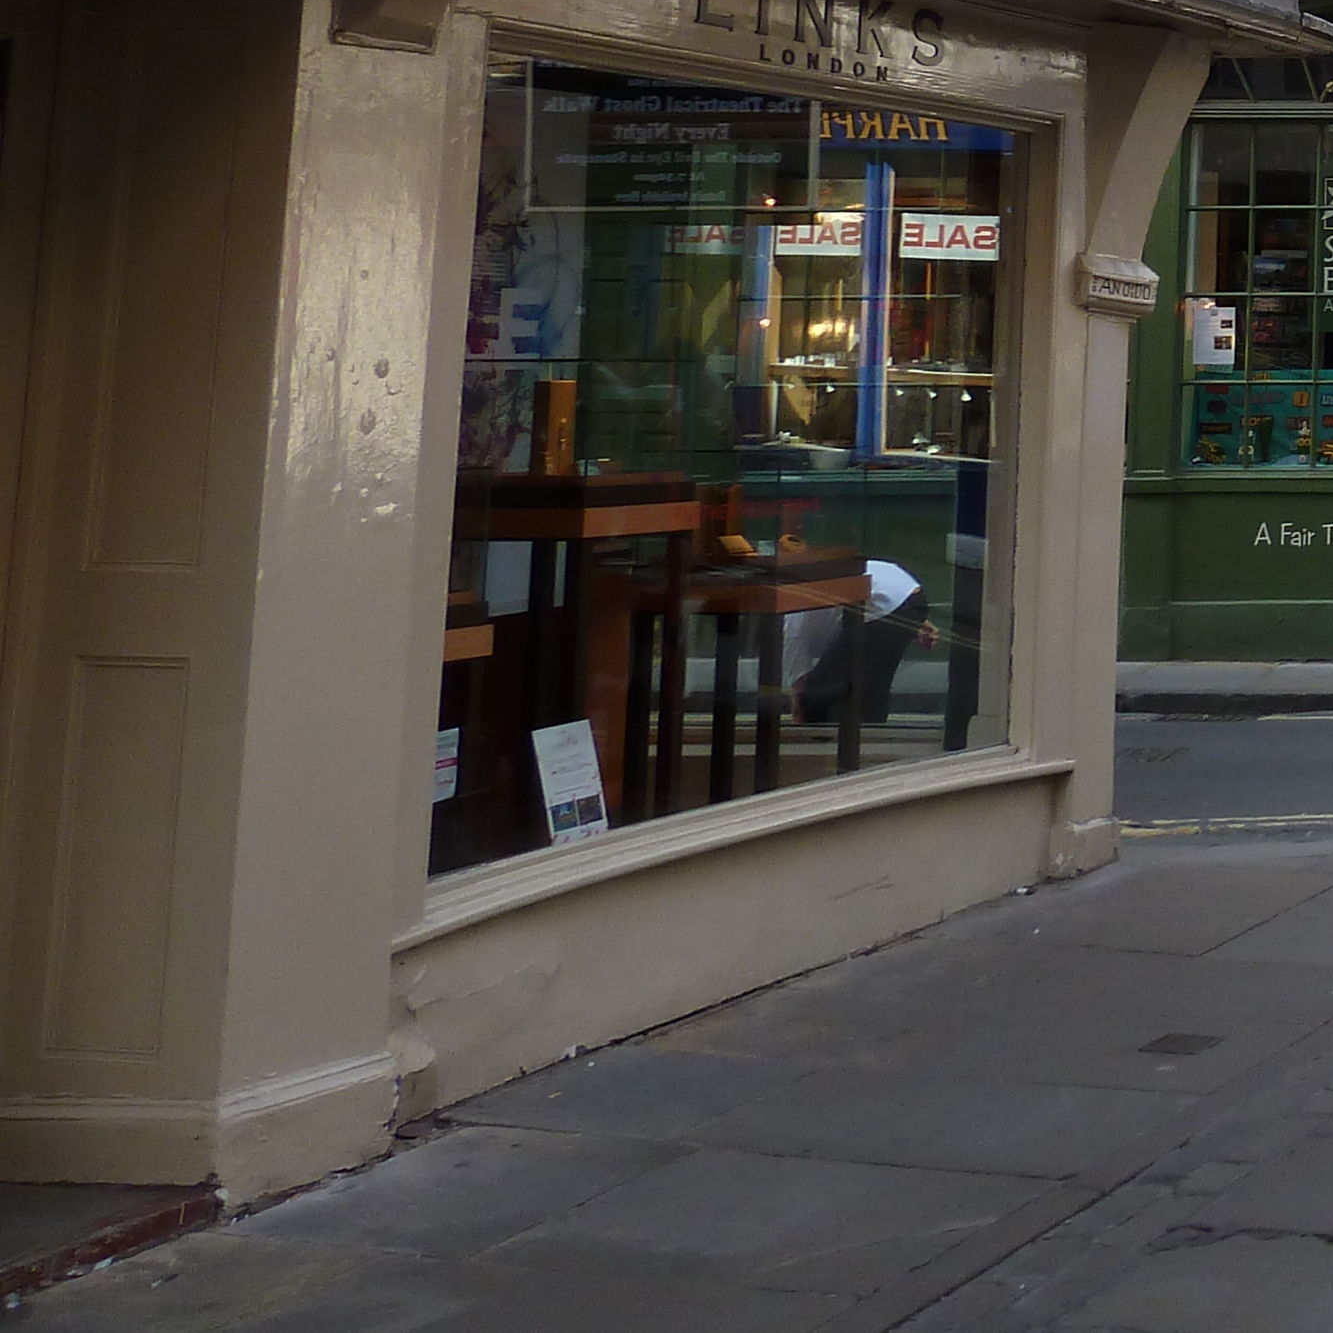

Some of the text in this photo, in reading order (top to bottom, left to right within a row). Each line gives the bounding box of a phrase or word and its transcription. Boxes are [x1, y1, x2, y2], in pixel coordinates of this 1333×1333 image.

[759, 44, 889, 81] LONDON
[1323, 299, 1333, 312] A
[1253, 523, 1272, 547] A
[1280, 523, 1316, 547] Fair
